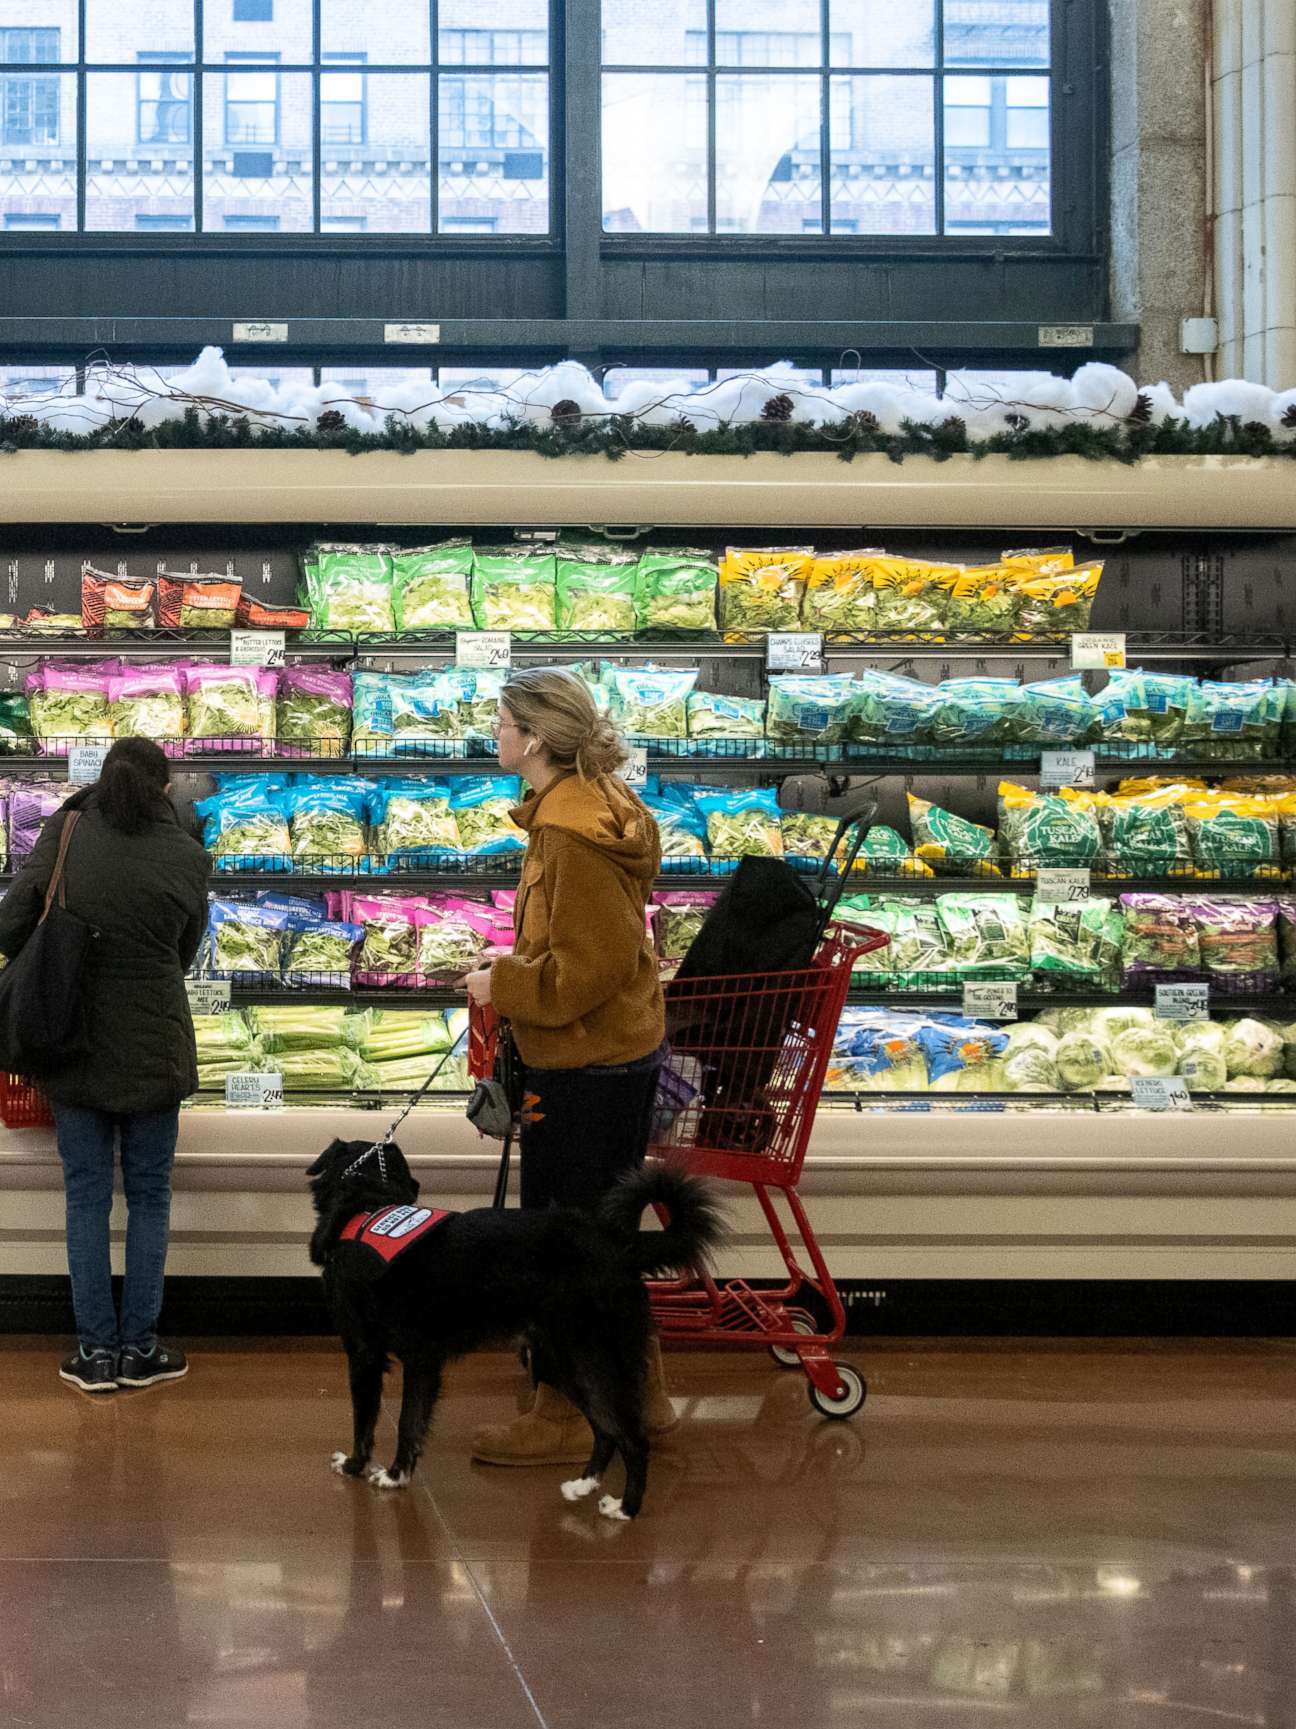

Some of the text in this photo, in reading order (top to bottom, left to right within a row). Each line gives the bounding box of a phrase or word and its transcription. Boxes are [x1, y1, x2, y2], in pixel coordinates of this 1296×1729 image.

[79, 750, 98, 758] BABY
[1056, 758, 1077, 767] KALE
[1049, 835, 1080, 844] KALE
[1222, 843, 1252, 853] KALE
[231, 1084, 261, 1092] HEARTS
